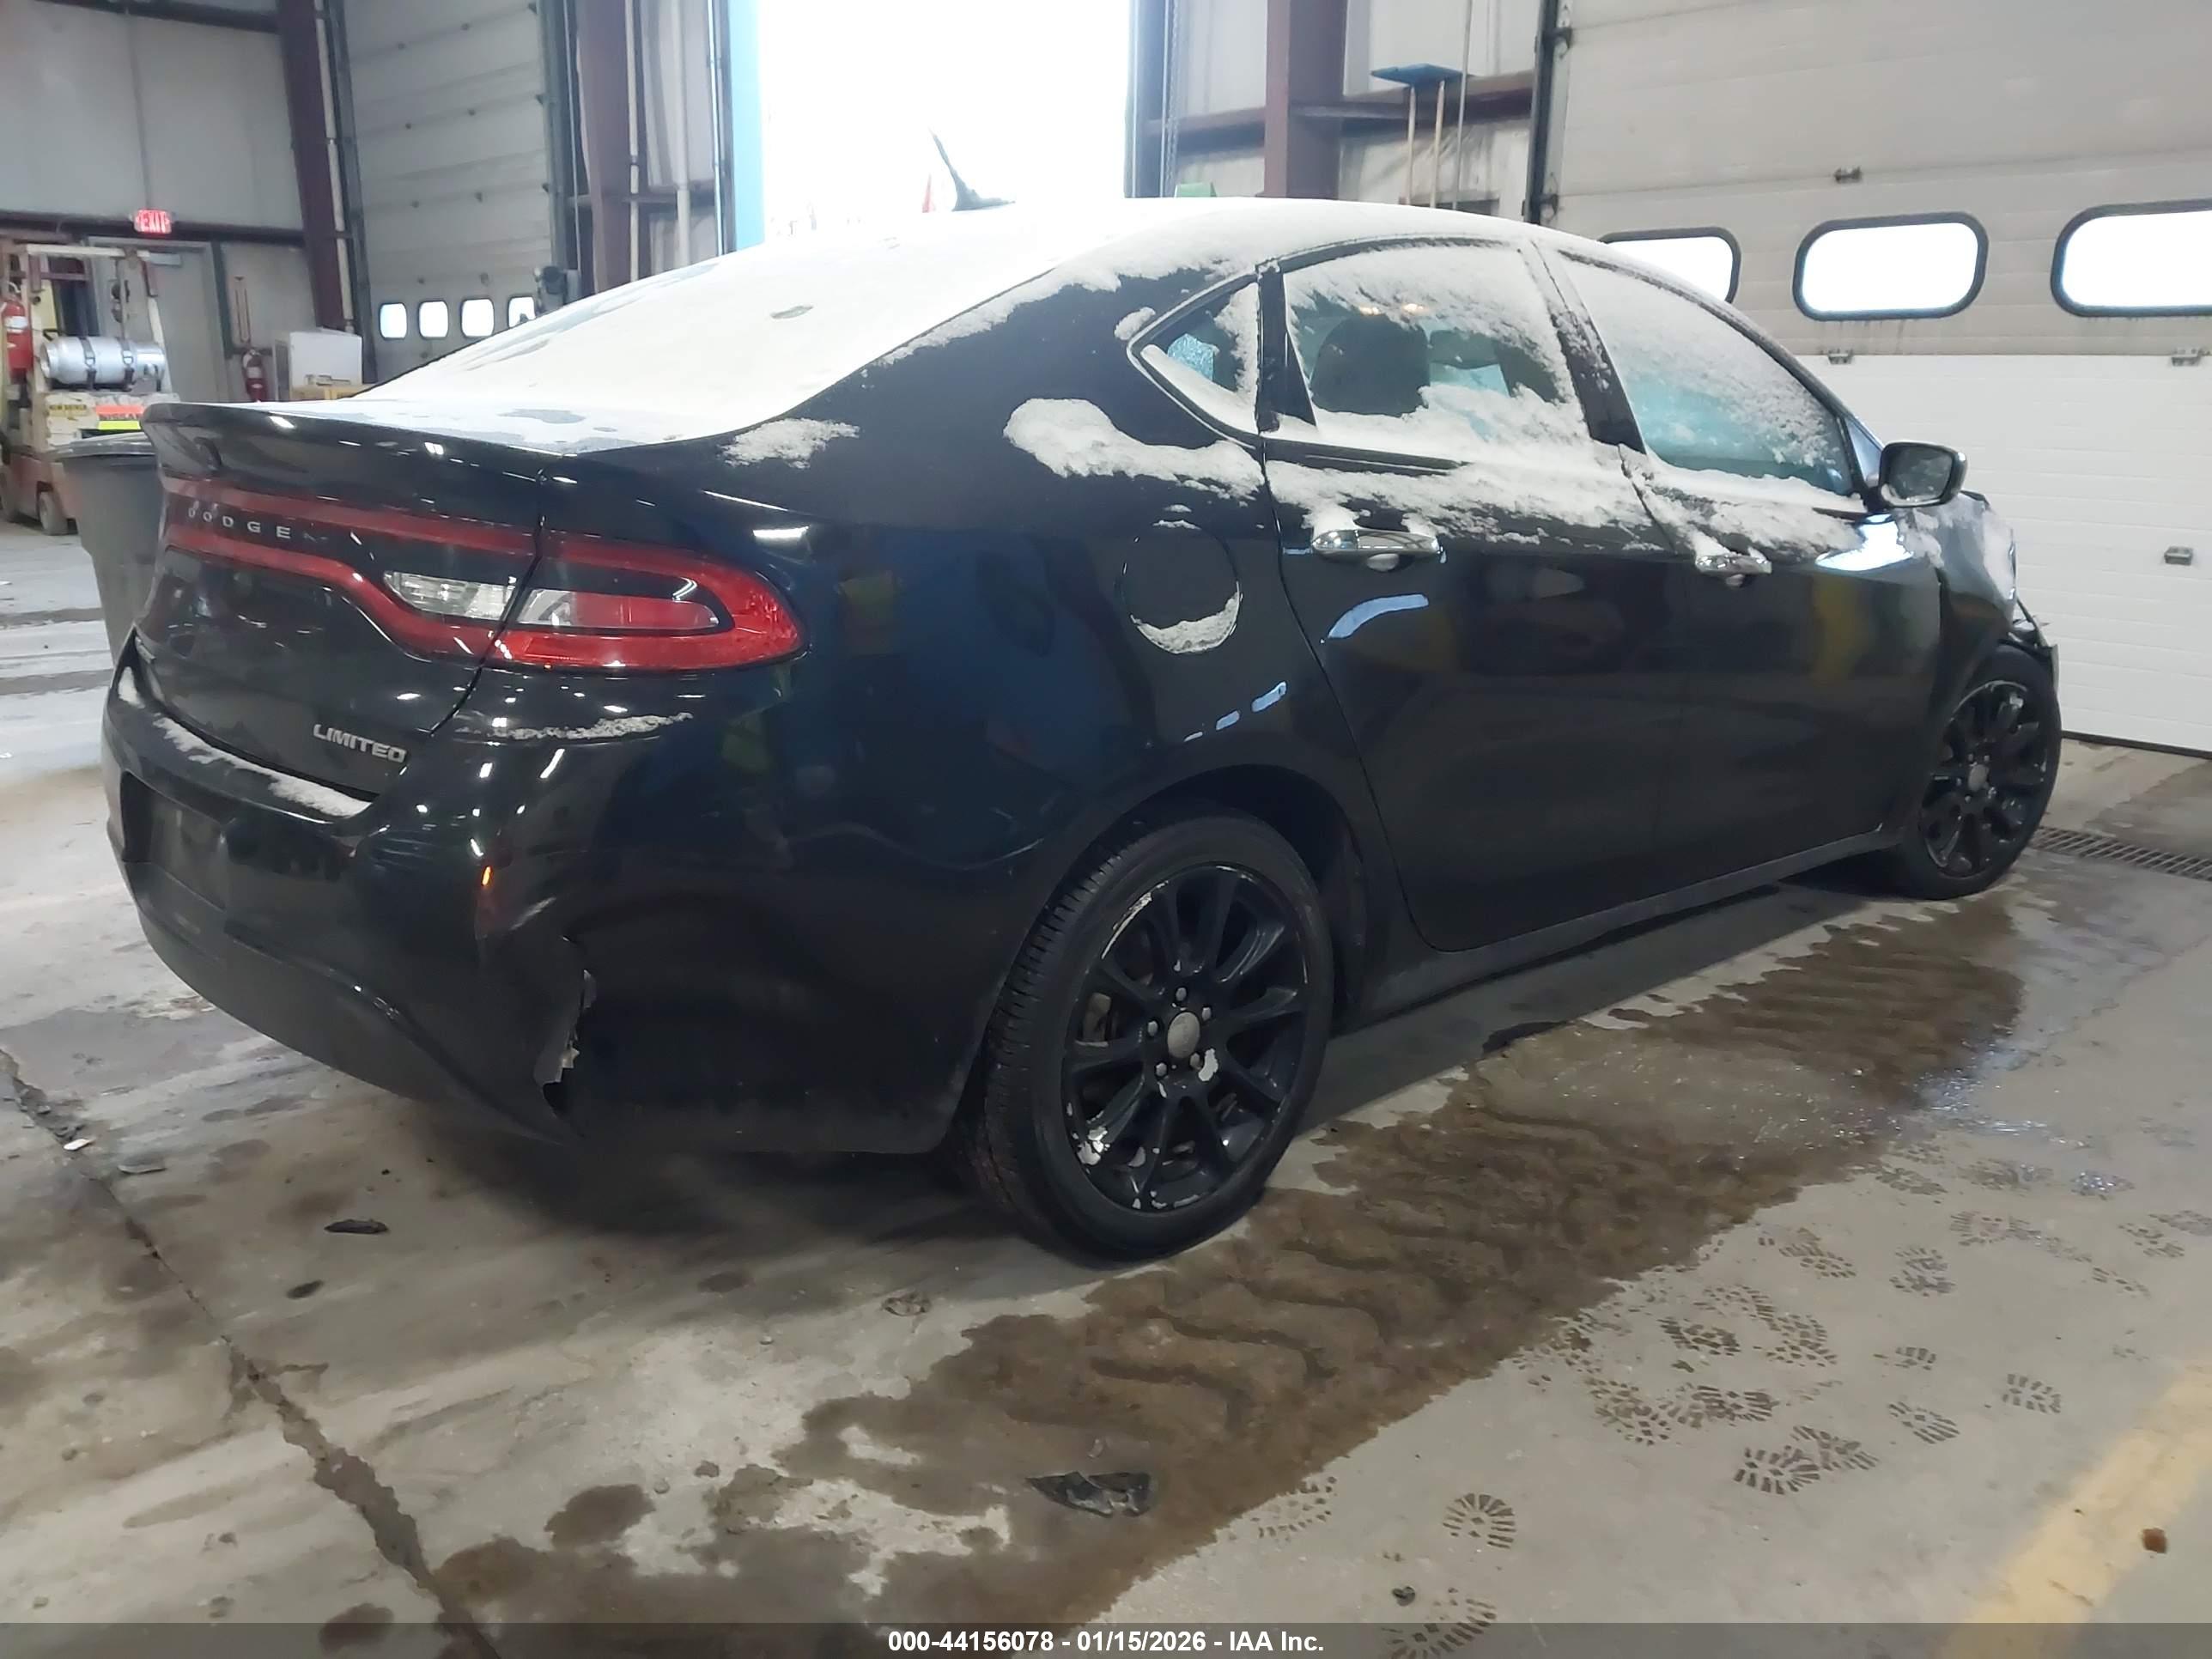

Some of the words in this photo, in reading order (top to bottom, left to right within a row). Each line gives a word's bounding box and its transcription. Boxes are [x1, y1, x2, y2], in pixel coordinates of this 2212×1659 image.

[140, 210, 166, 233] EXIT
[188, 507, 291, 539] DODGE
[313, 723, 407, 763] LIMITED
